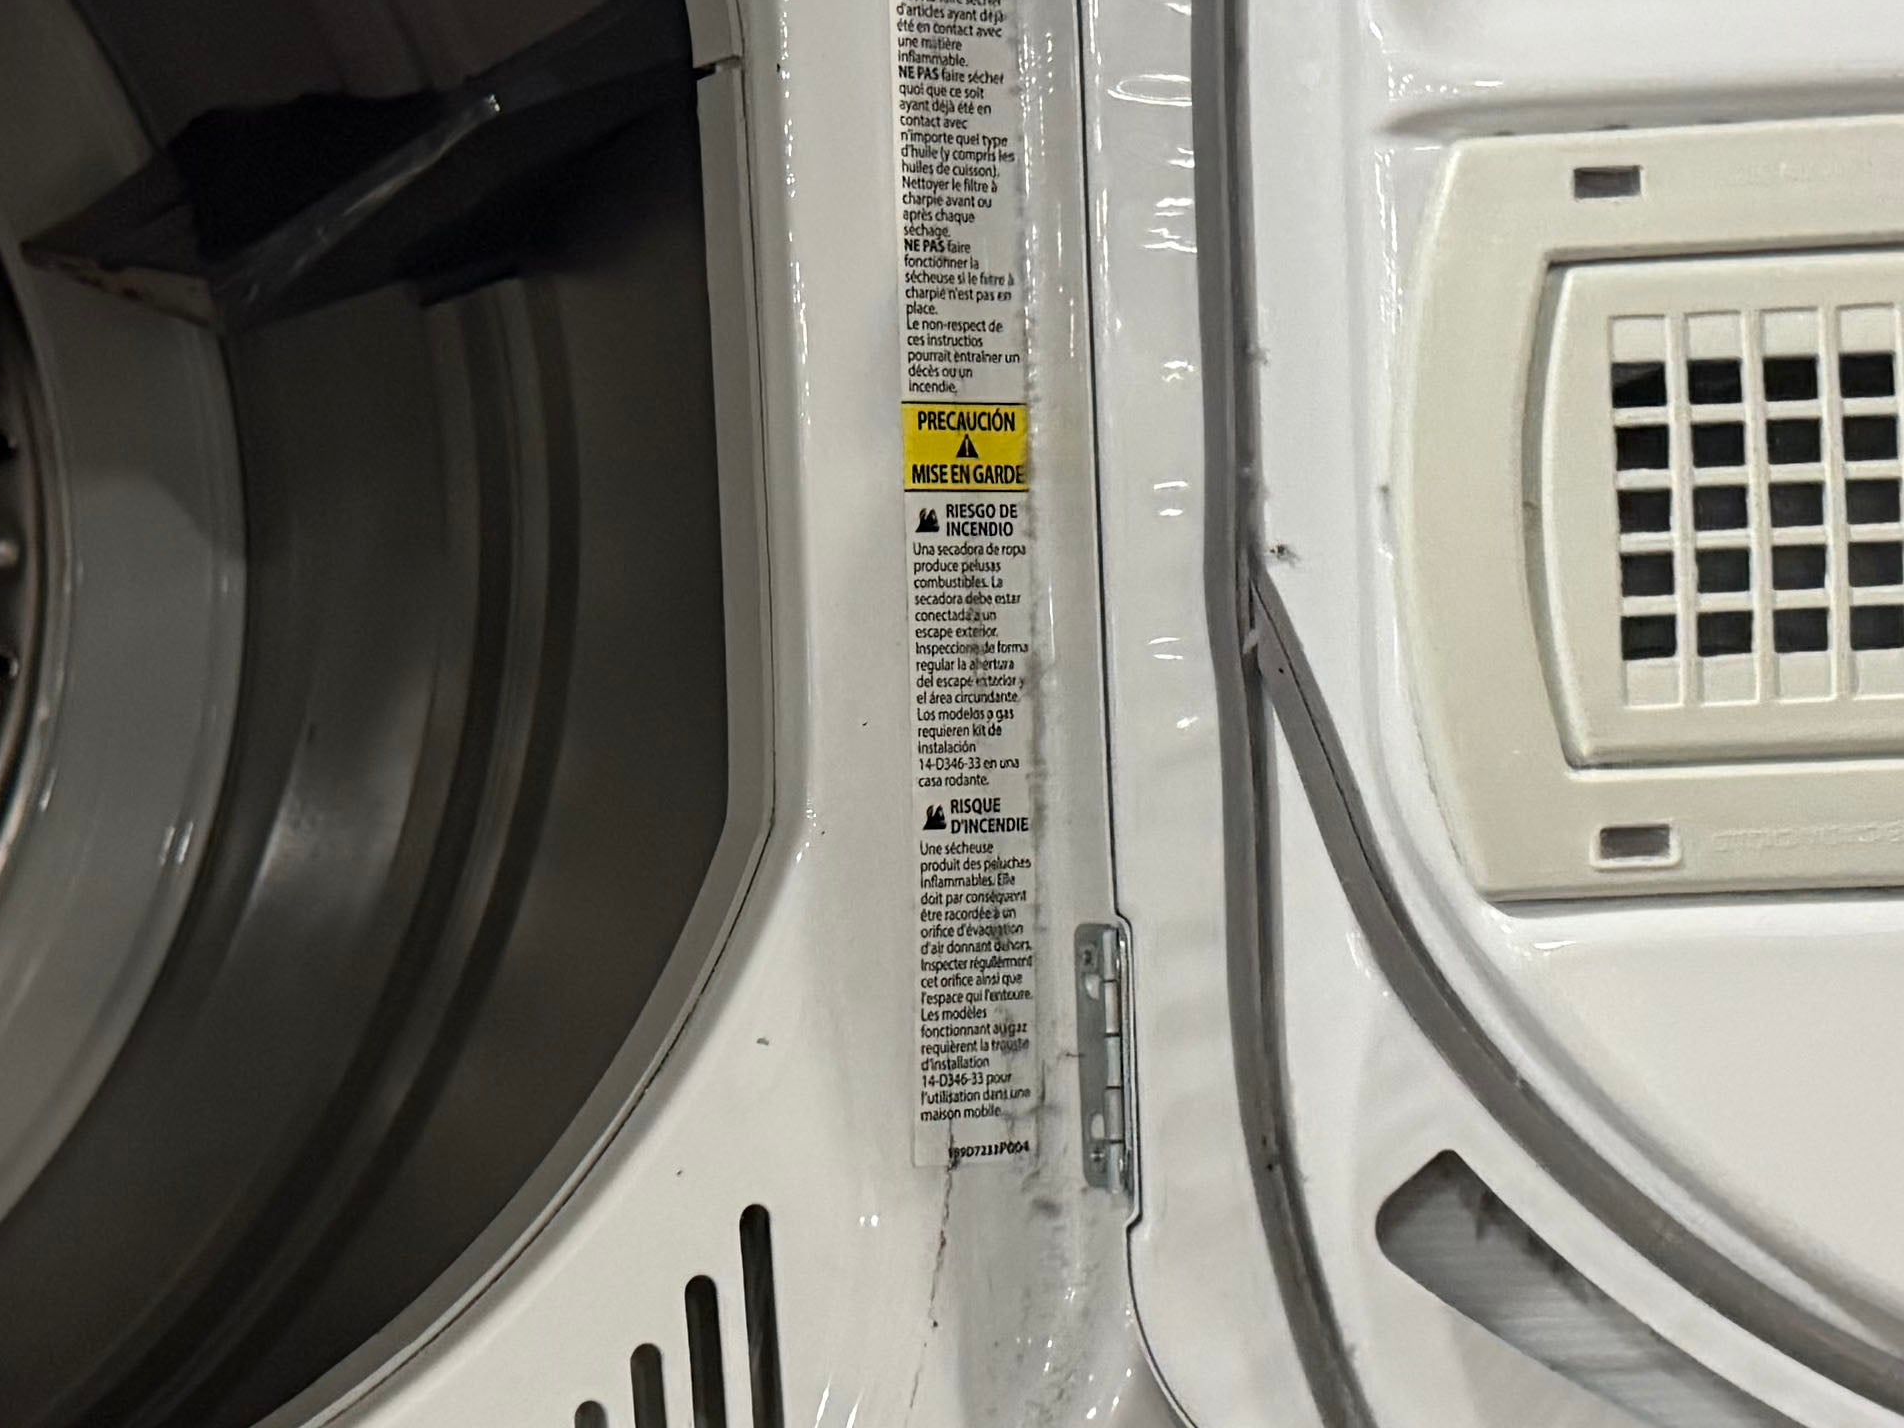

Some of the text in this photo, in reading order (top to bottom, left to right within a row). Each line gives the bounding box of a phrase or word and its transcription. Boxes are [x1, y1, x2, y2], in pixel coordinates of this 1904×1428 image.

[905, 238, 945, 253] NE PAS
[917, 408, 1016, 433] PRECAUCIÓN
[911, 464, 1024, 484] MISE EN GARDE
[946, 504, 1018, 519] RIESGO DE
[946, 521, 1014, 537] INCENDIO
[950, 798, 1001, 814] RISQUE
